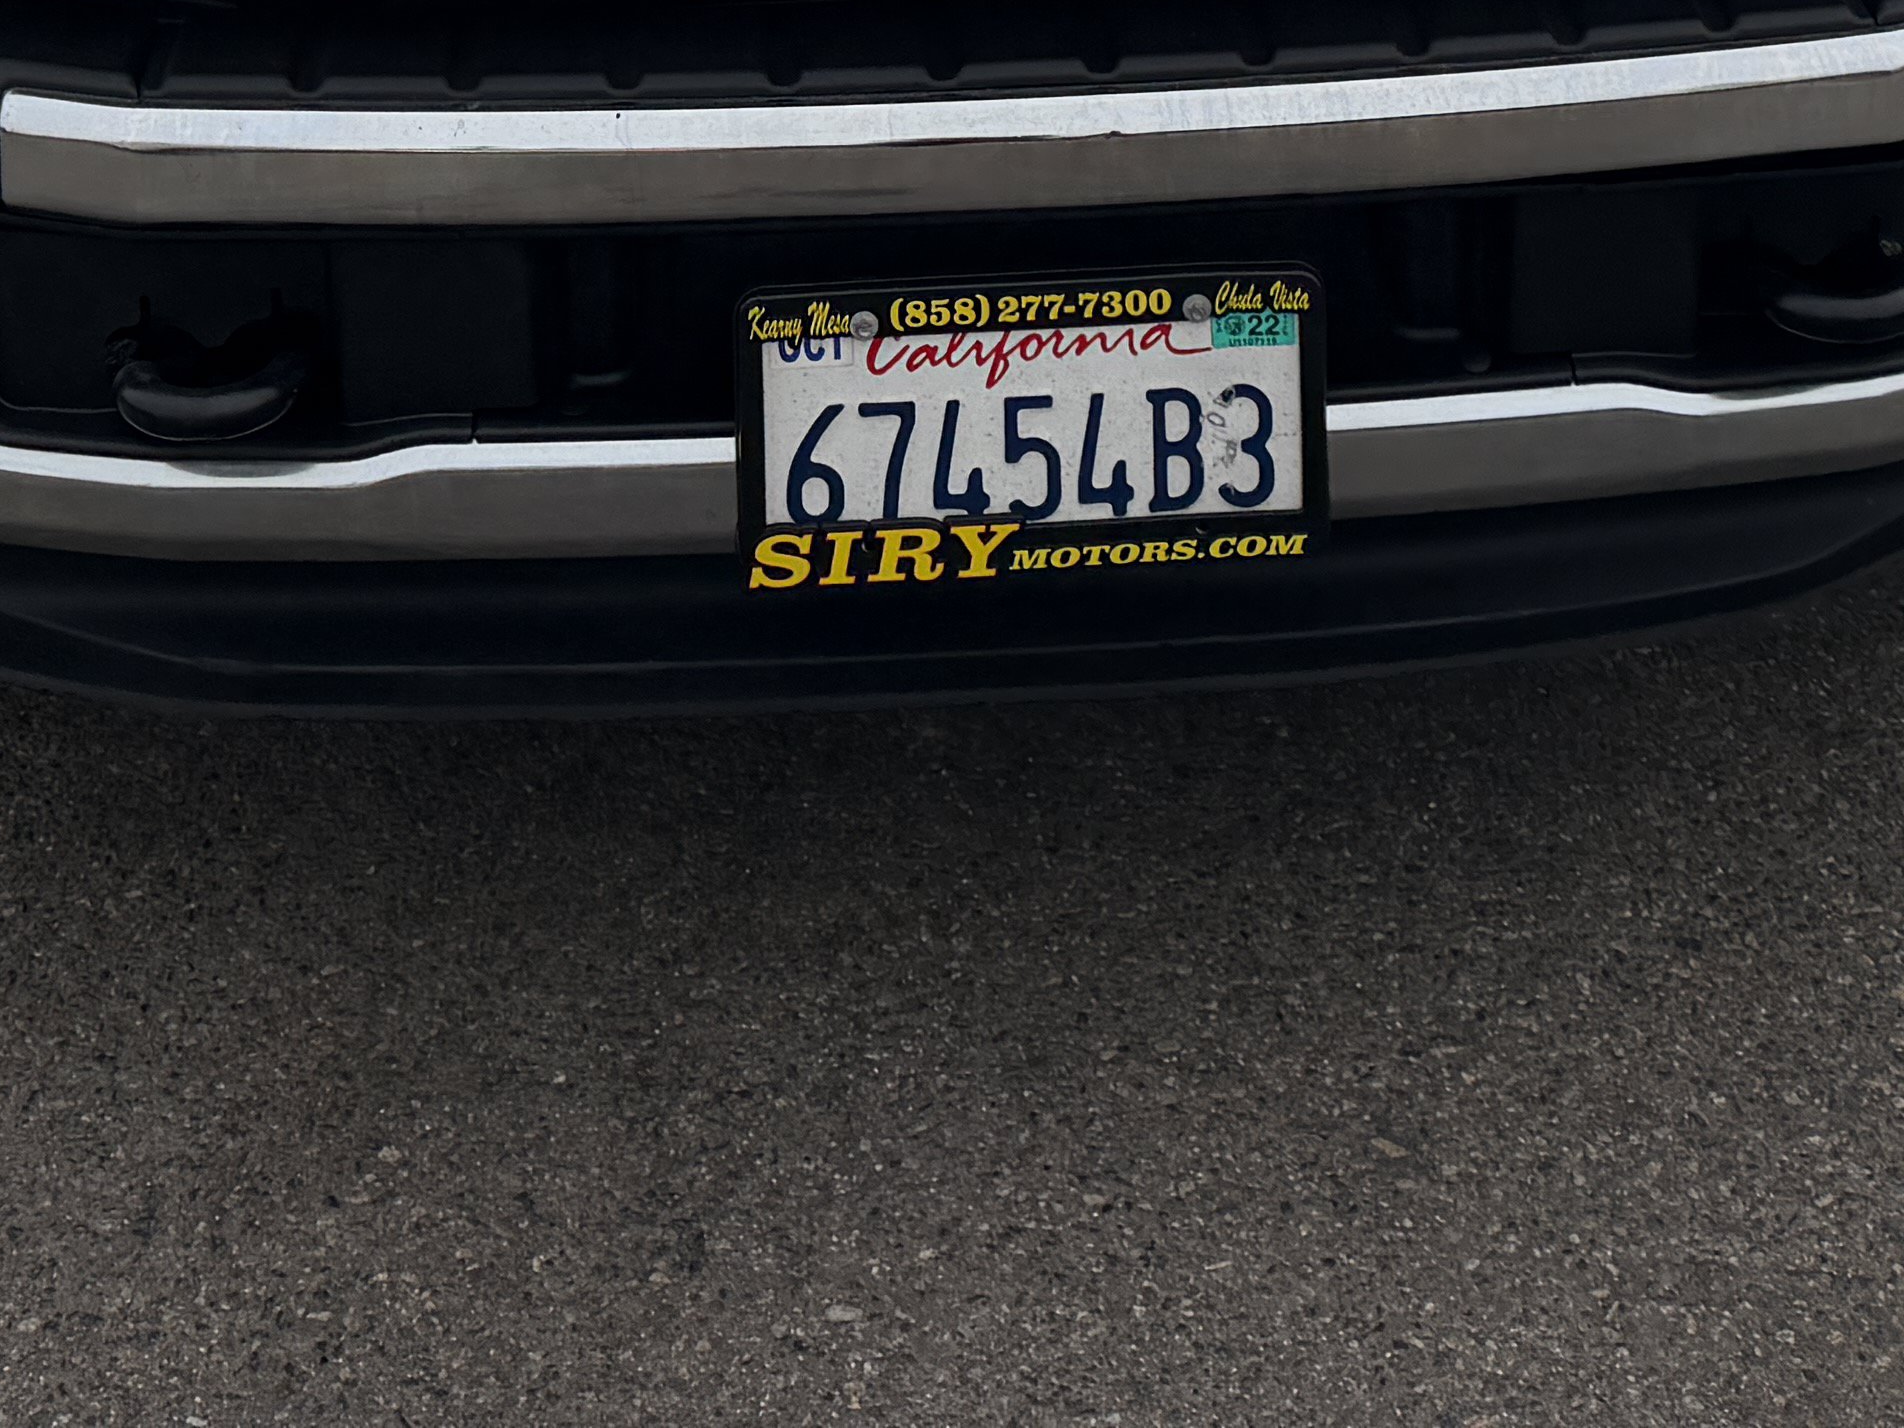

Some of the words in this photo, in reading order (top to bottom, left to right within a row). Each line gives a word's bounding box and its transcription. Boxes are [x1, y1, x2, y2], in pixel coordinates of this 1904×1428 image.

[890, 293, 991, 331] (858)
[997, 287, 1173, 324] 277-7300
[1214, 280, 1264, 316] Chula
[1269, 279, 1311, 311] Vista
[747, 305, 803, 345] Kearny
[807, 299, 850, 337] Mesa
[1247, 314, 1281, 336] 22
[865, 321, 1213, 389] California
[785, 383, 1275, 524] 67454B3
[748, 522, 1020, 590] SIRY
[1008, 533, 1308, 573] MOTORS.COM
